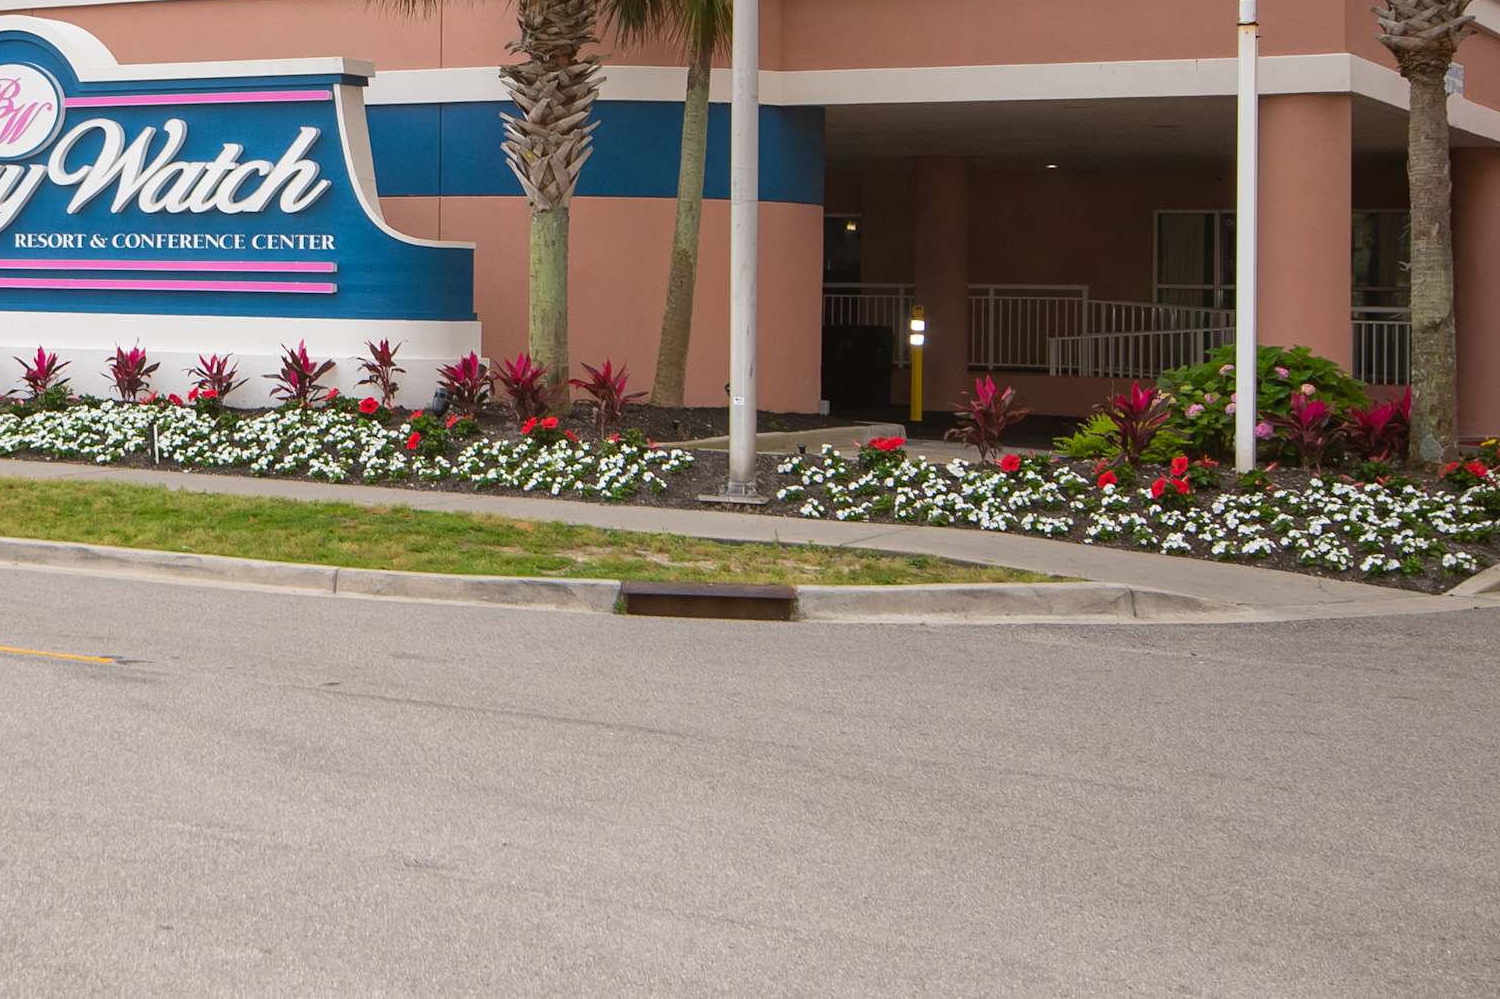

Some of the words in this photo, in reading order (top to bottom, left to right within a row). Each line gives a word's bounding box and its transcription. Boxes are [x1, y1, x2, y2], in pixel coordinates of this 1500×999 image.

[48, 118, 332, 215] Watch
[14, 233, 87, 249] RESORT
[90, 233, 108, 249] &
[111, 233, 245, 250] CONFERENCE
[251, 233, 336, 251] CENTER
